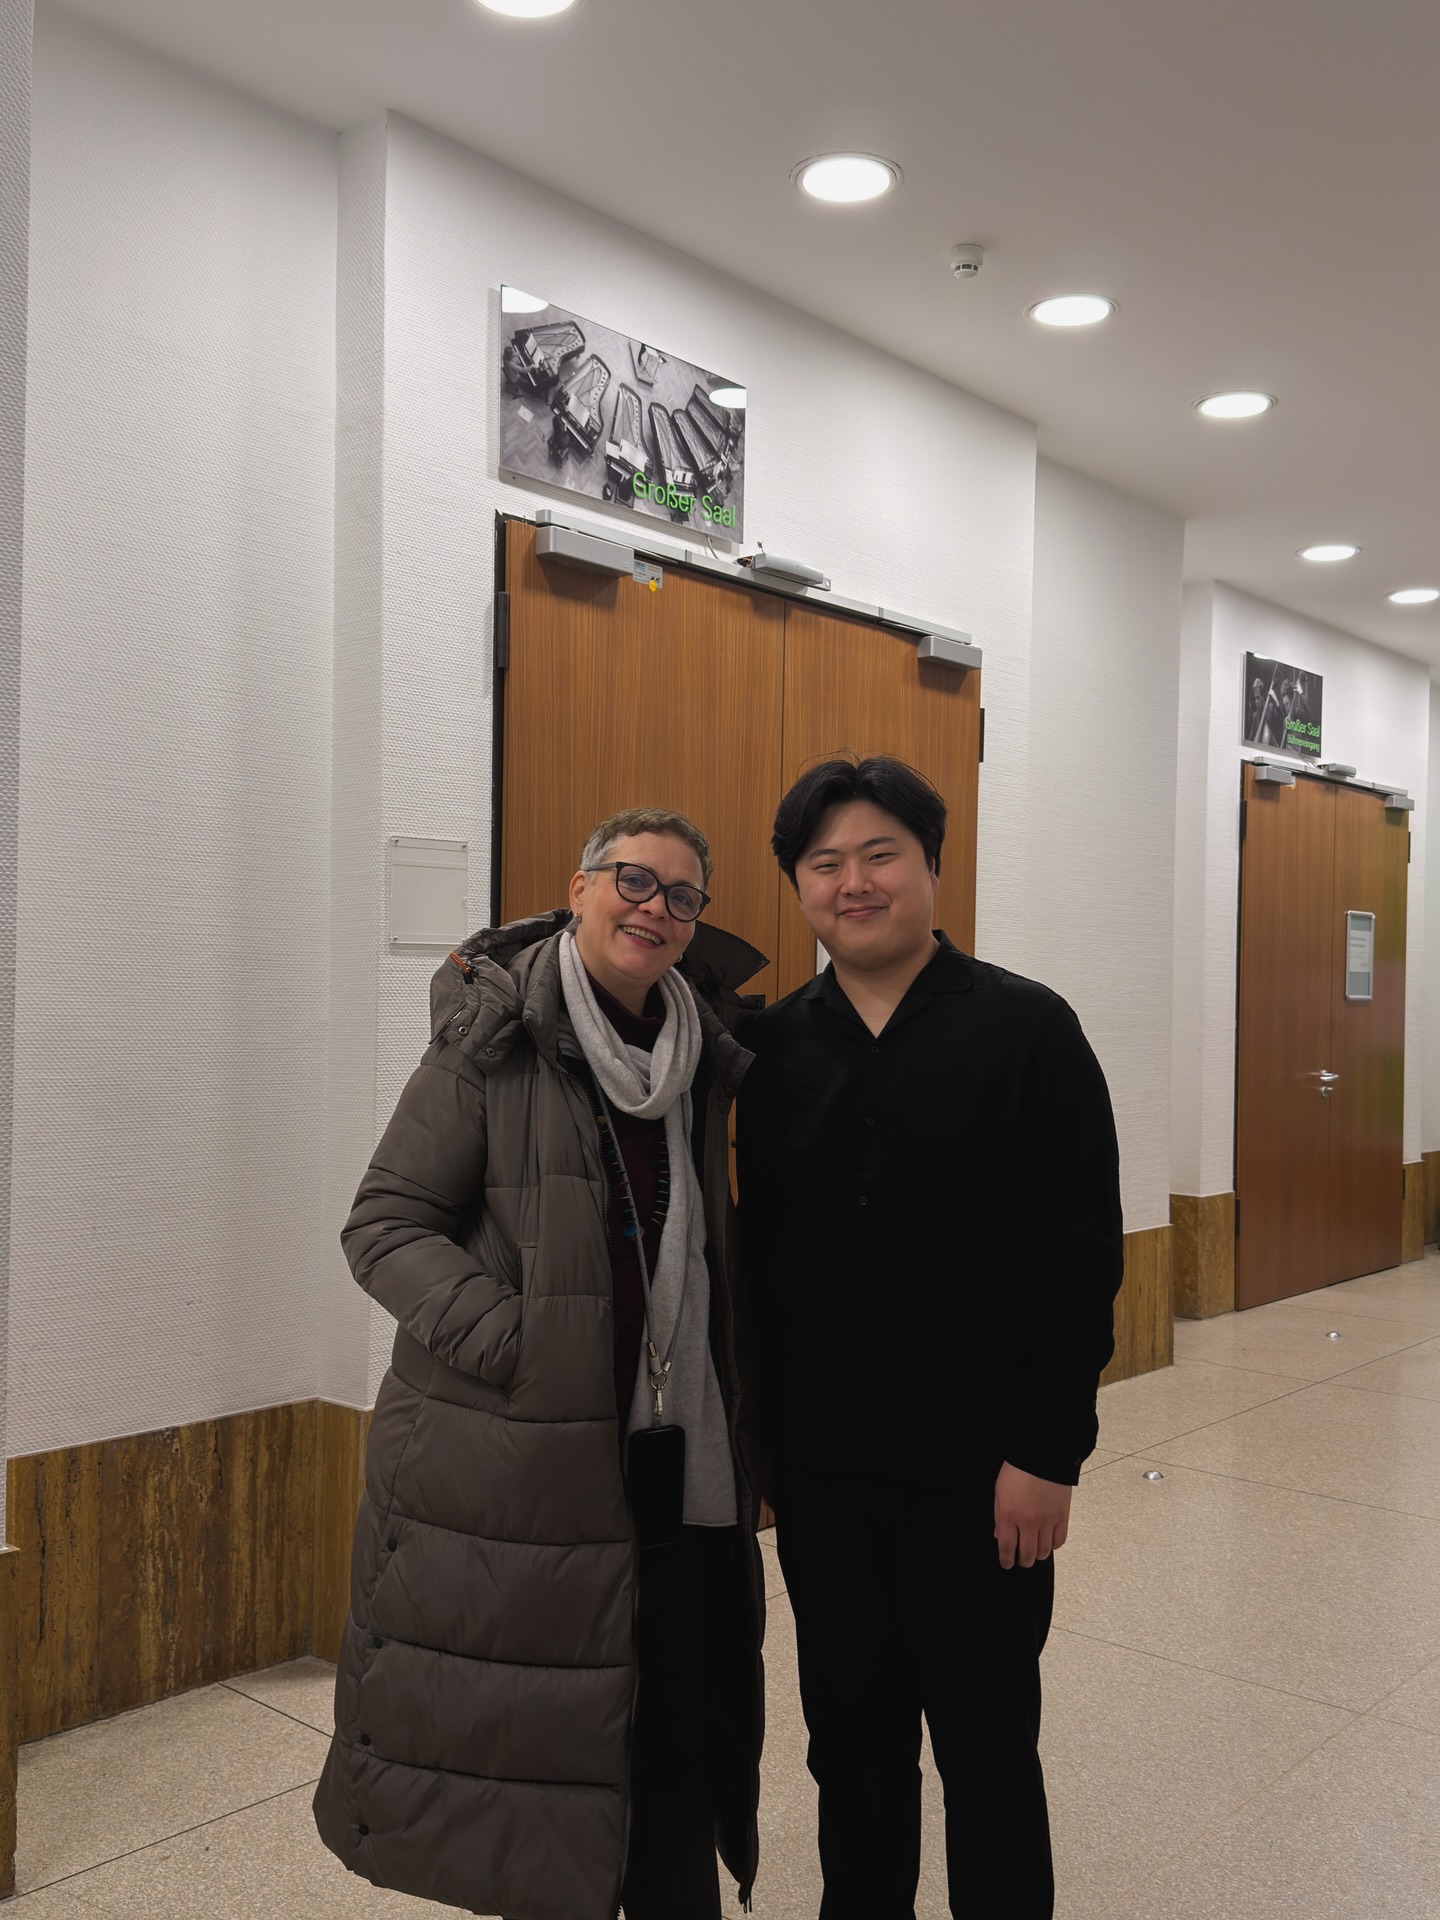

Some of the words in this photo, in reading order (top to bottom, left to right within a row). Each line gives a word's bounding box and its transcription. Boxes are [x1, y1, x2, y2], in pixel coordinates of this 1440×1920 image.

[632, 471, 697, 513] Großer
[701, 495, 737, 528] Saal
[1285, 716, 1307, 734] Großer
[1307, 722, 1320, 737] Saal
